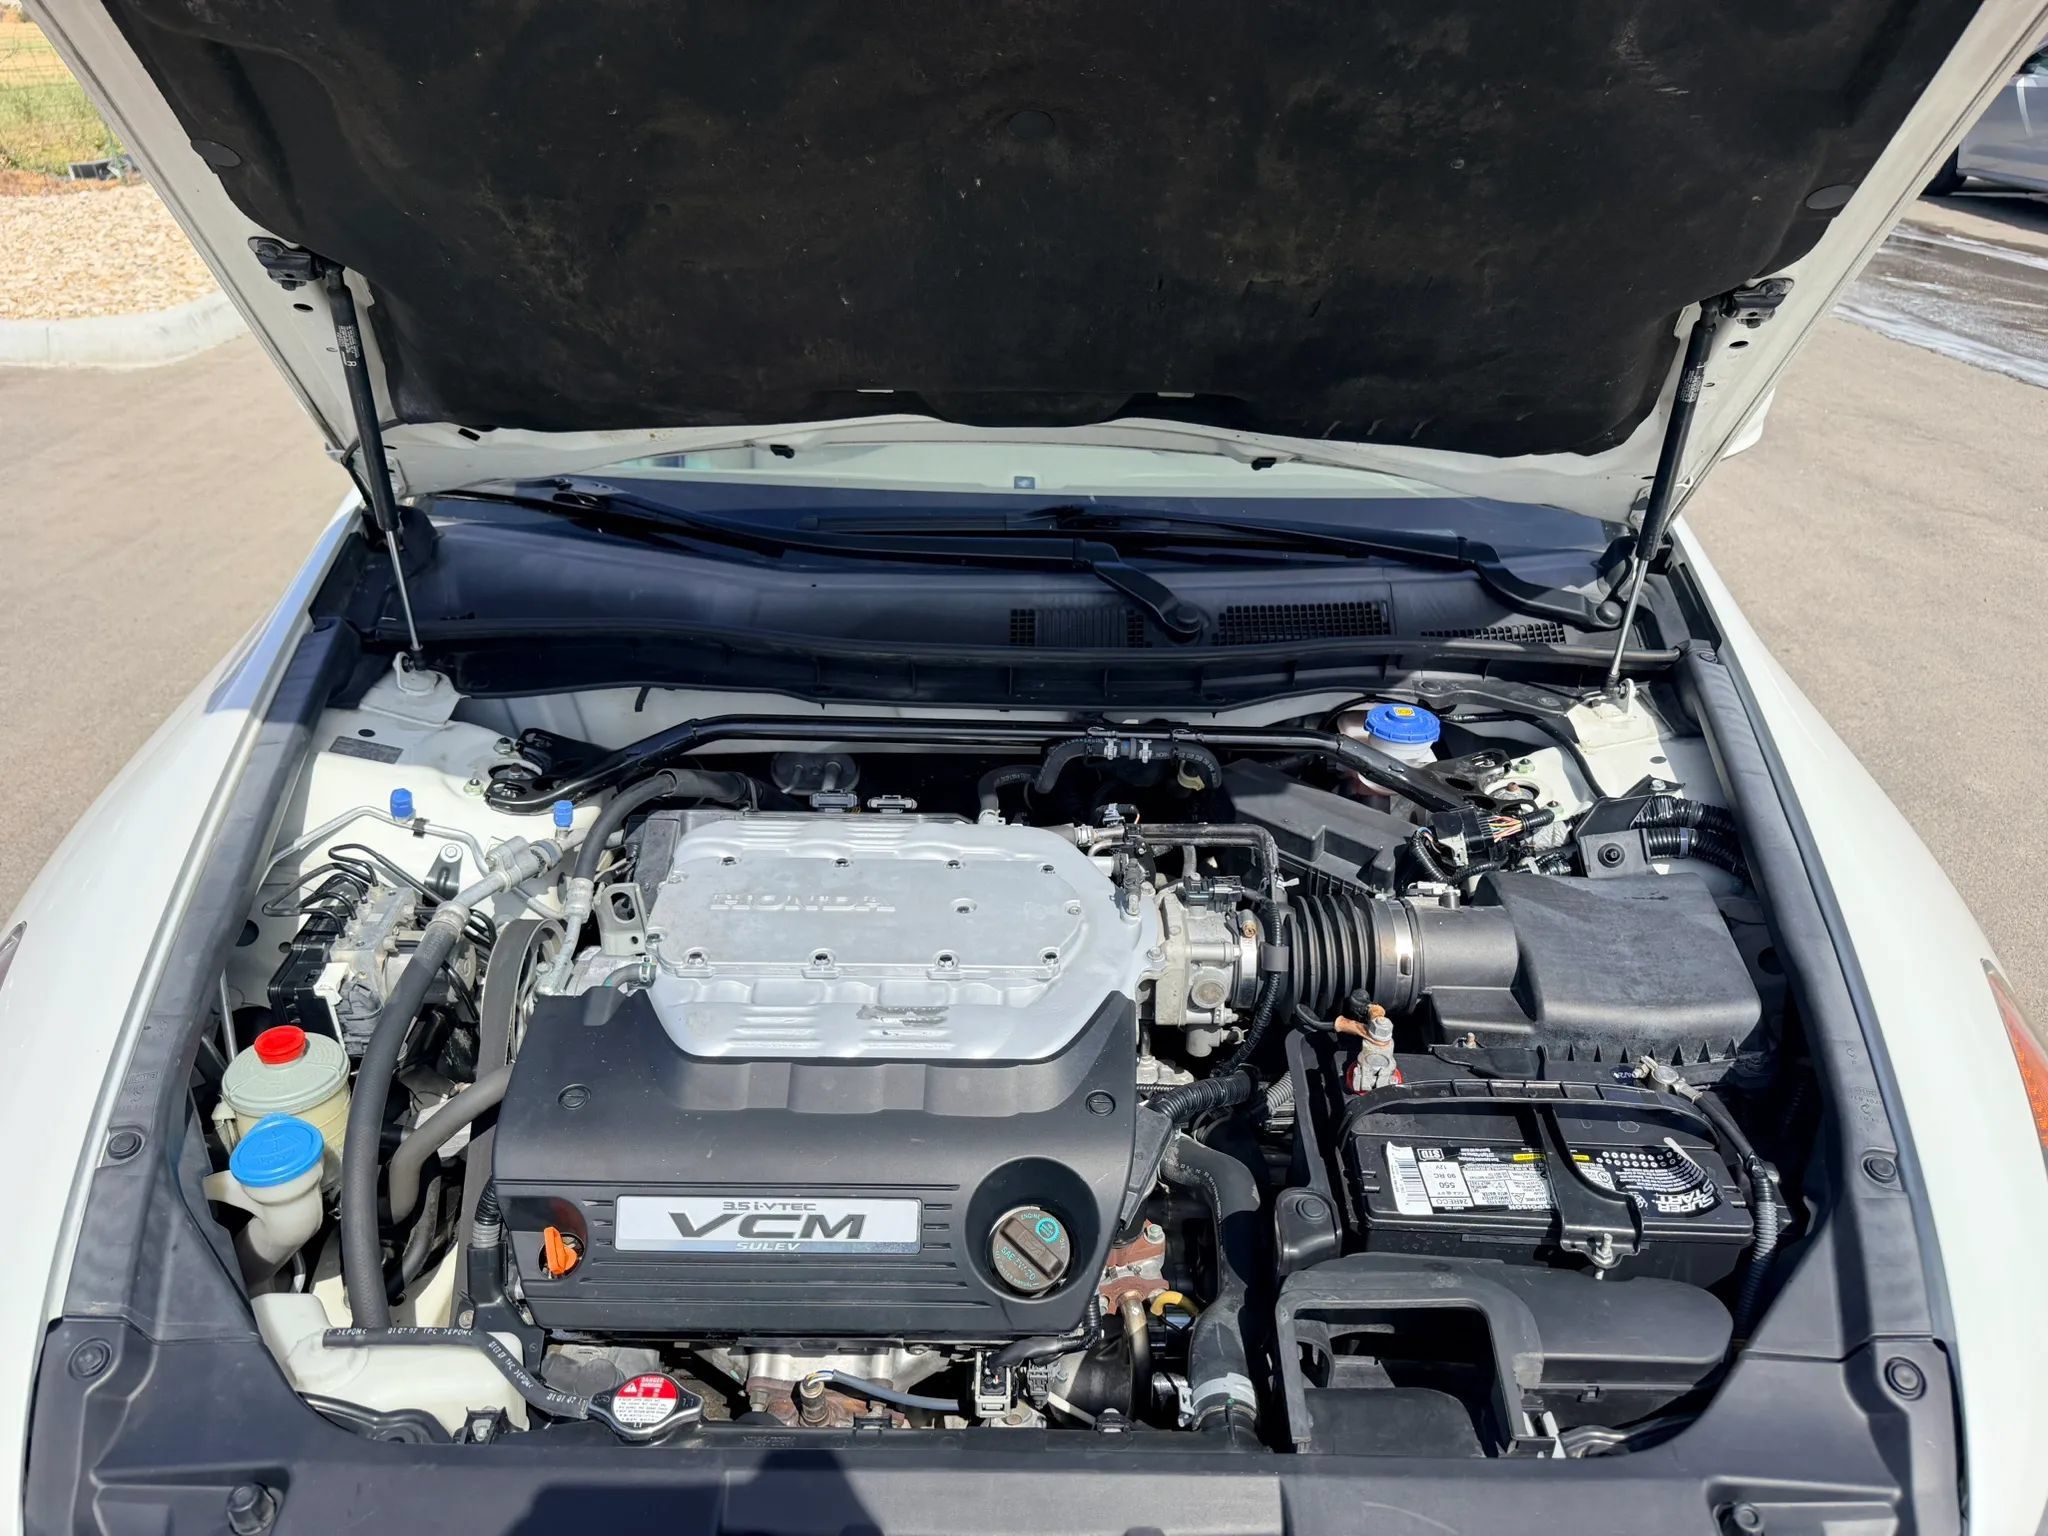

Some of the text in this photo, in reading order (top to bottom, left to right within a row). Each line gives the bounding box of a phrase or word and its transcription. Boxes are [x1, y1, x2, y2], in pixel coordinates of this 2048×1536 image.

[710, 894, 896, 911] HONDA
[1655, 1177, 1713, 1203] START
[1657, 1195, 1714, 1213] SUPER
[668, 1211, 866, 1240] VCM
[736, 1242, 801, 1251] SULEV
[1001, 1247, 1015, 1261] SAE
